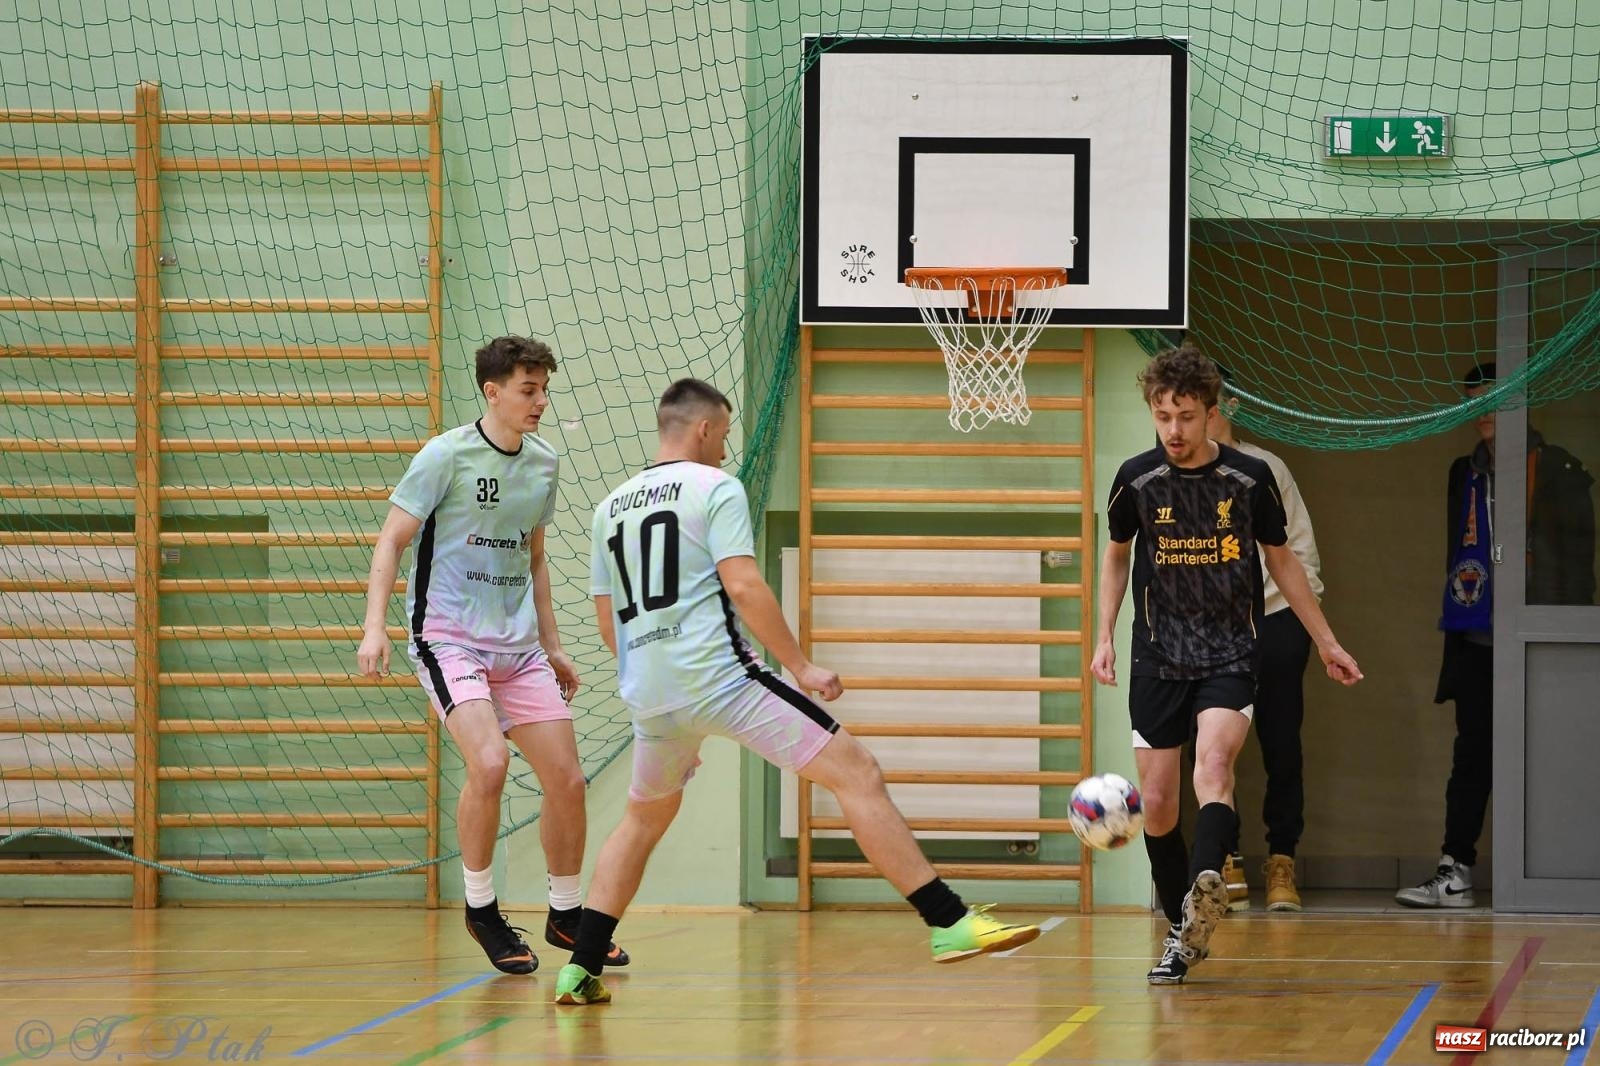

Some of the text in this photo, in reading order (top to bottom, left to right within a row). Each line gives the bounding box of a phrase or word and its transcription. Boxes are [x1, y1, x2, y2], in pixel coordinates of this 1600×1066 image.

[841, 244, 876, 259] SURE
[840, 269, 875, 284] SHOT
[476, 478, 500, 503] 32
[610, 482, 682, 519] CIUĆMAN
[467, 533, 517, 549] Concrete
[1158, 535, 1217, 549] Standard
[1155, 551, 1218, 565] Chartered
[607, 510, 680, 625] 10
